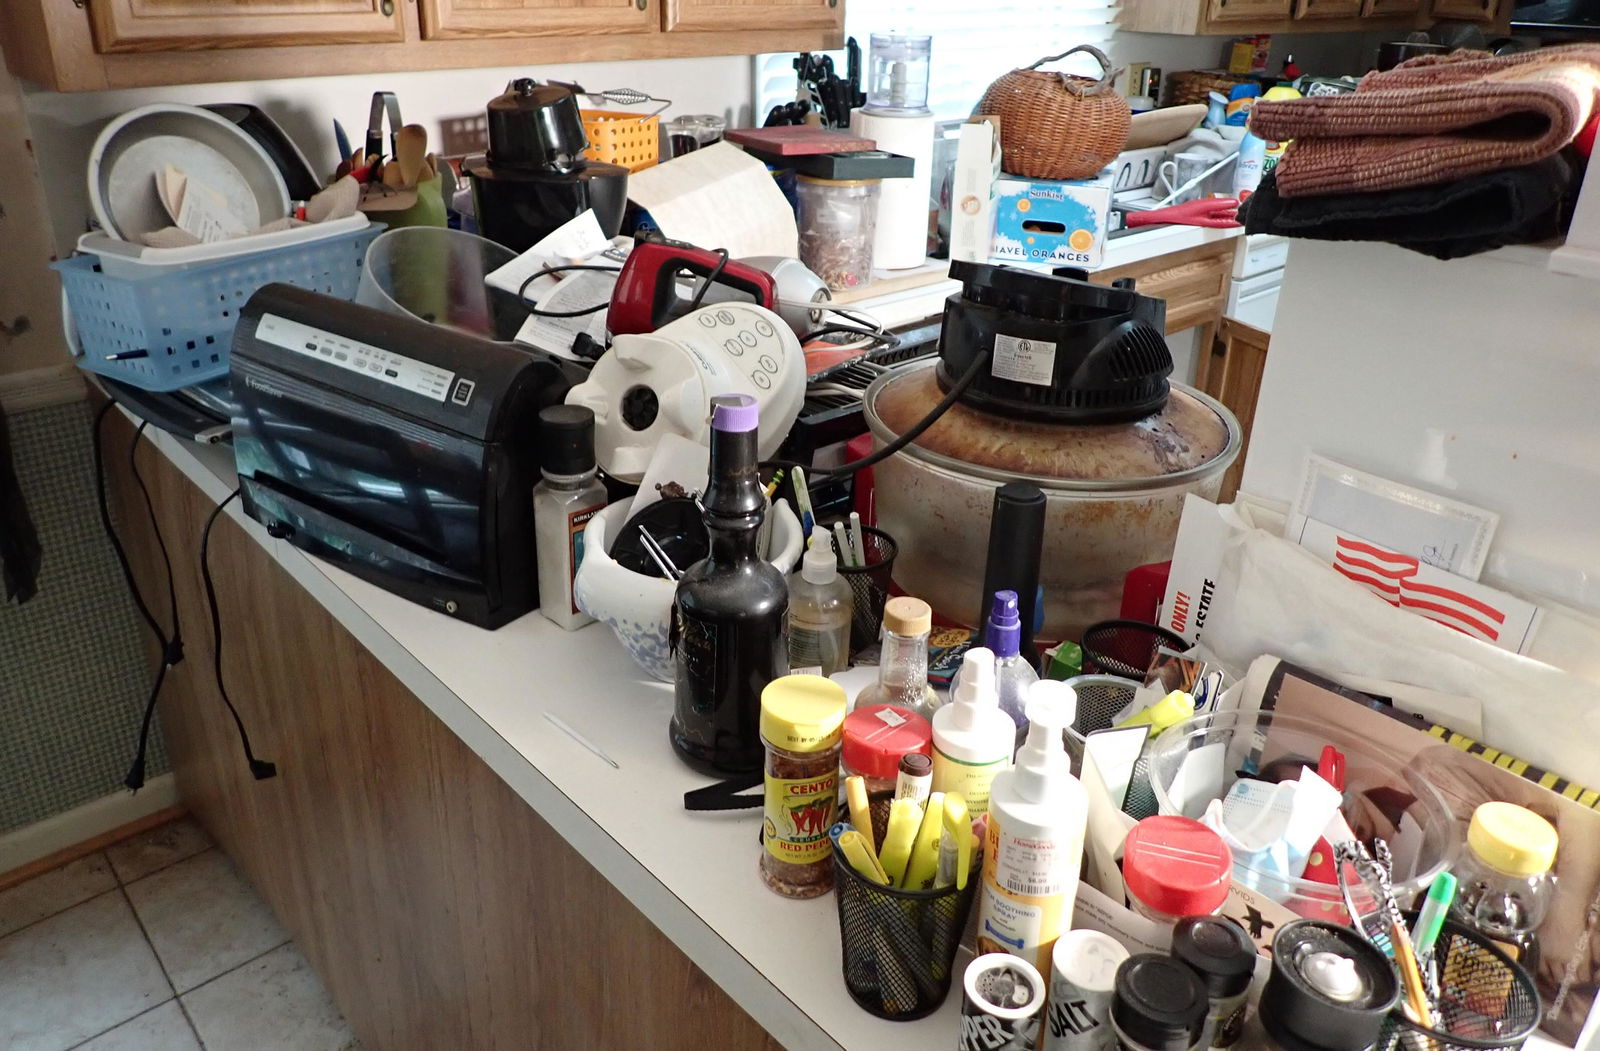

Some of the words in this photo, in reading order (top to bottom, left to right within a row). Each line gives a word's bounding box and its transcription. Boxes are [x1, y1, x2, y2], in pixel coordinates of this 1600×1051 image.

[1030, 189, 1064, 200] Sunkist
[1032, 249, 1090, 262] ORANGES
[1170, 591, 1191, 633] ONLY!
[790, 779, 833, 795] CENTO
[780, 841, 802, 852] RED
[805, 836, 831, 852] PEPP
[993, 904, 1017, 921] SPRAY
[995, 898, 1036, 918] SOOTHING
[1047, 1001, 1100, 1038] SALT
